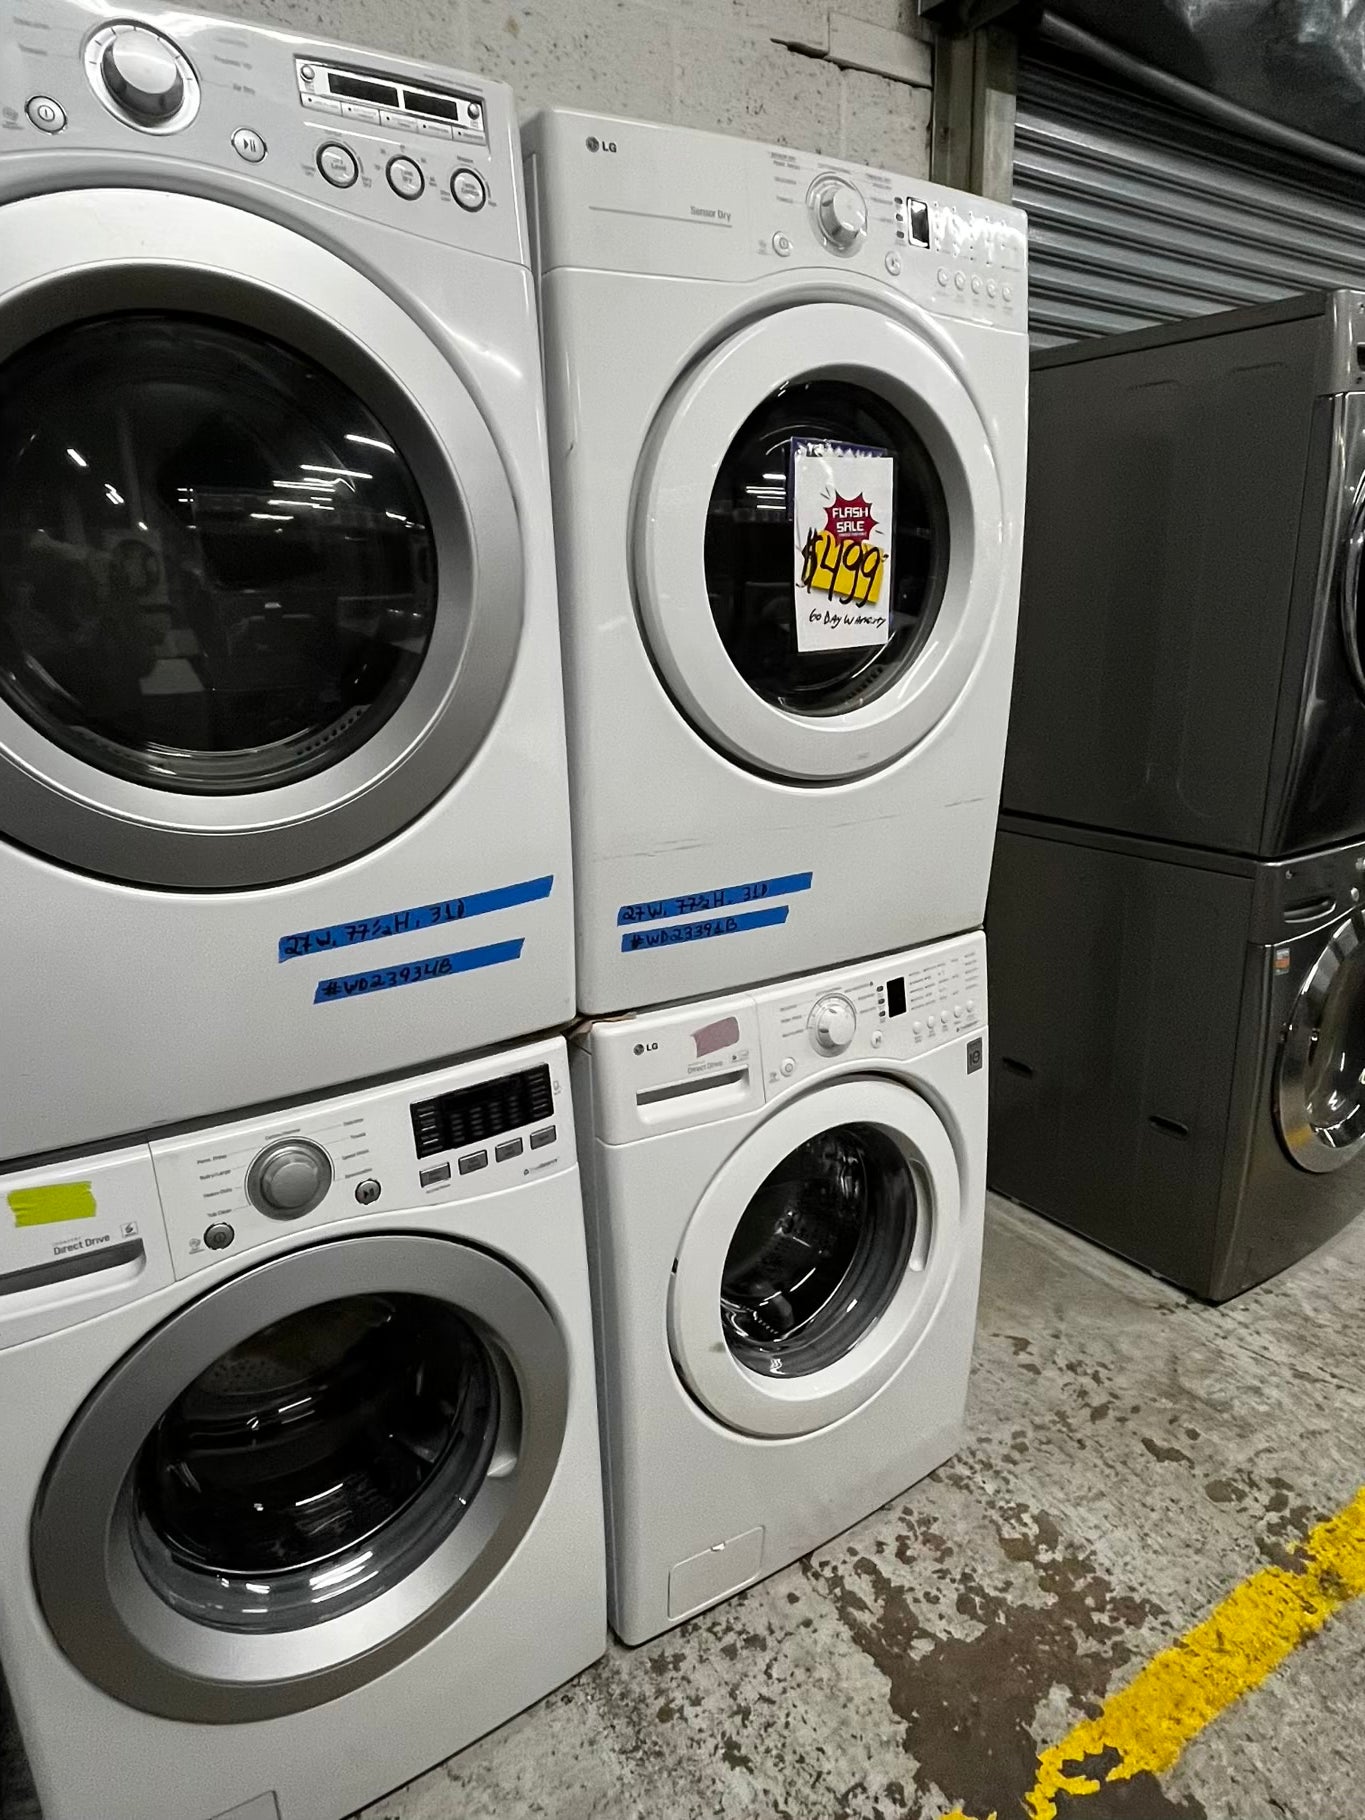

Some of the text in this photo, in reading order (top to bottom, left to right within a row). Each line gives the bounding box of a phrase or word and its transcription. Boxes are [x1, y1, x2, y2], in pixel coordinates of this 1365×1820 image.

[602, 141, 617, 153] LG
[690, 205, 732, 222] Sensor Dry
[832, 506, 869, 518] FLASH
[836, 520, 865, 533] SALE
[646, 1042, 659, 1052] LG
[53, 1241, 83, 1256] Direct
[85, 1234, 111, 1247] Drive
